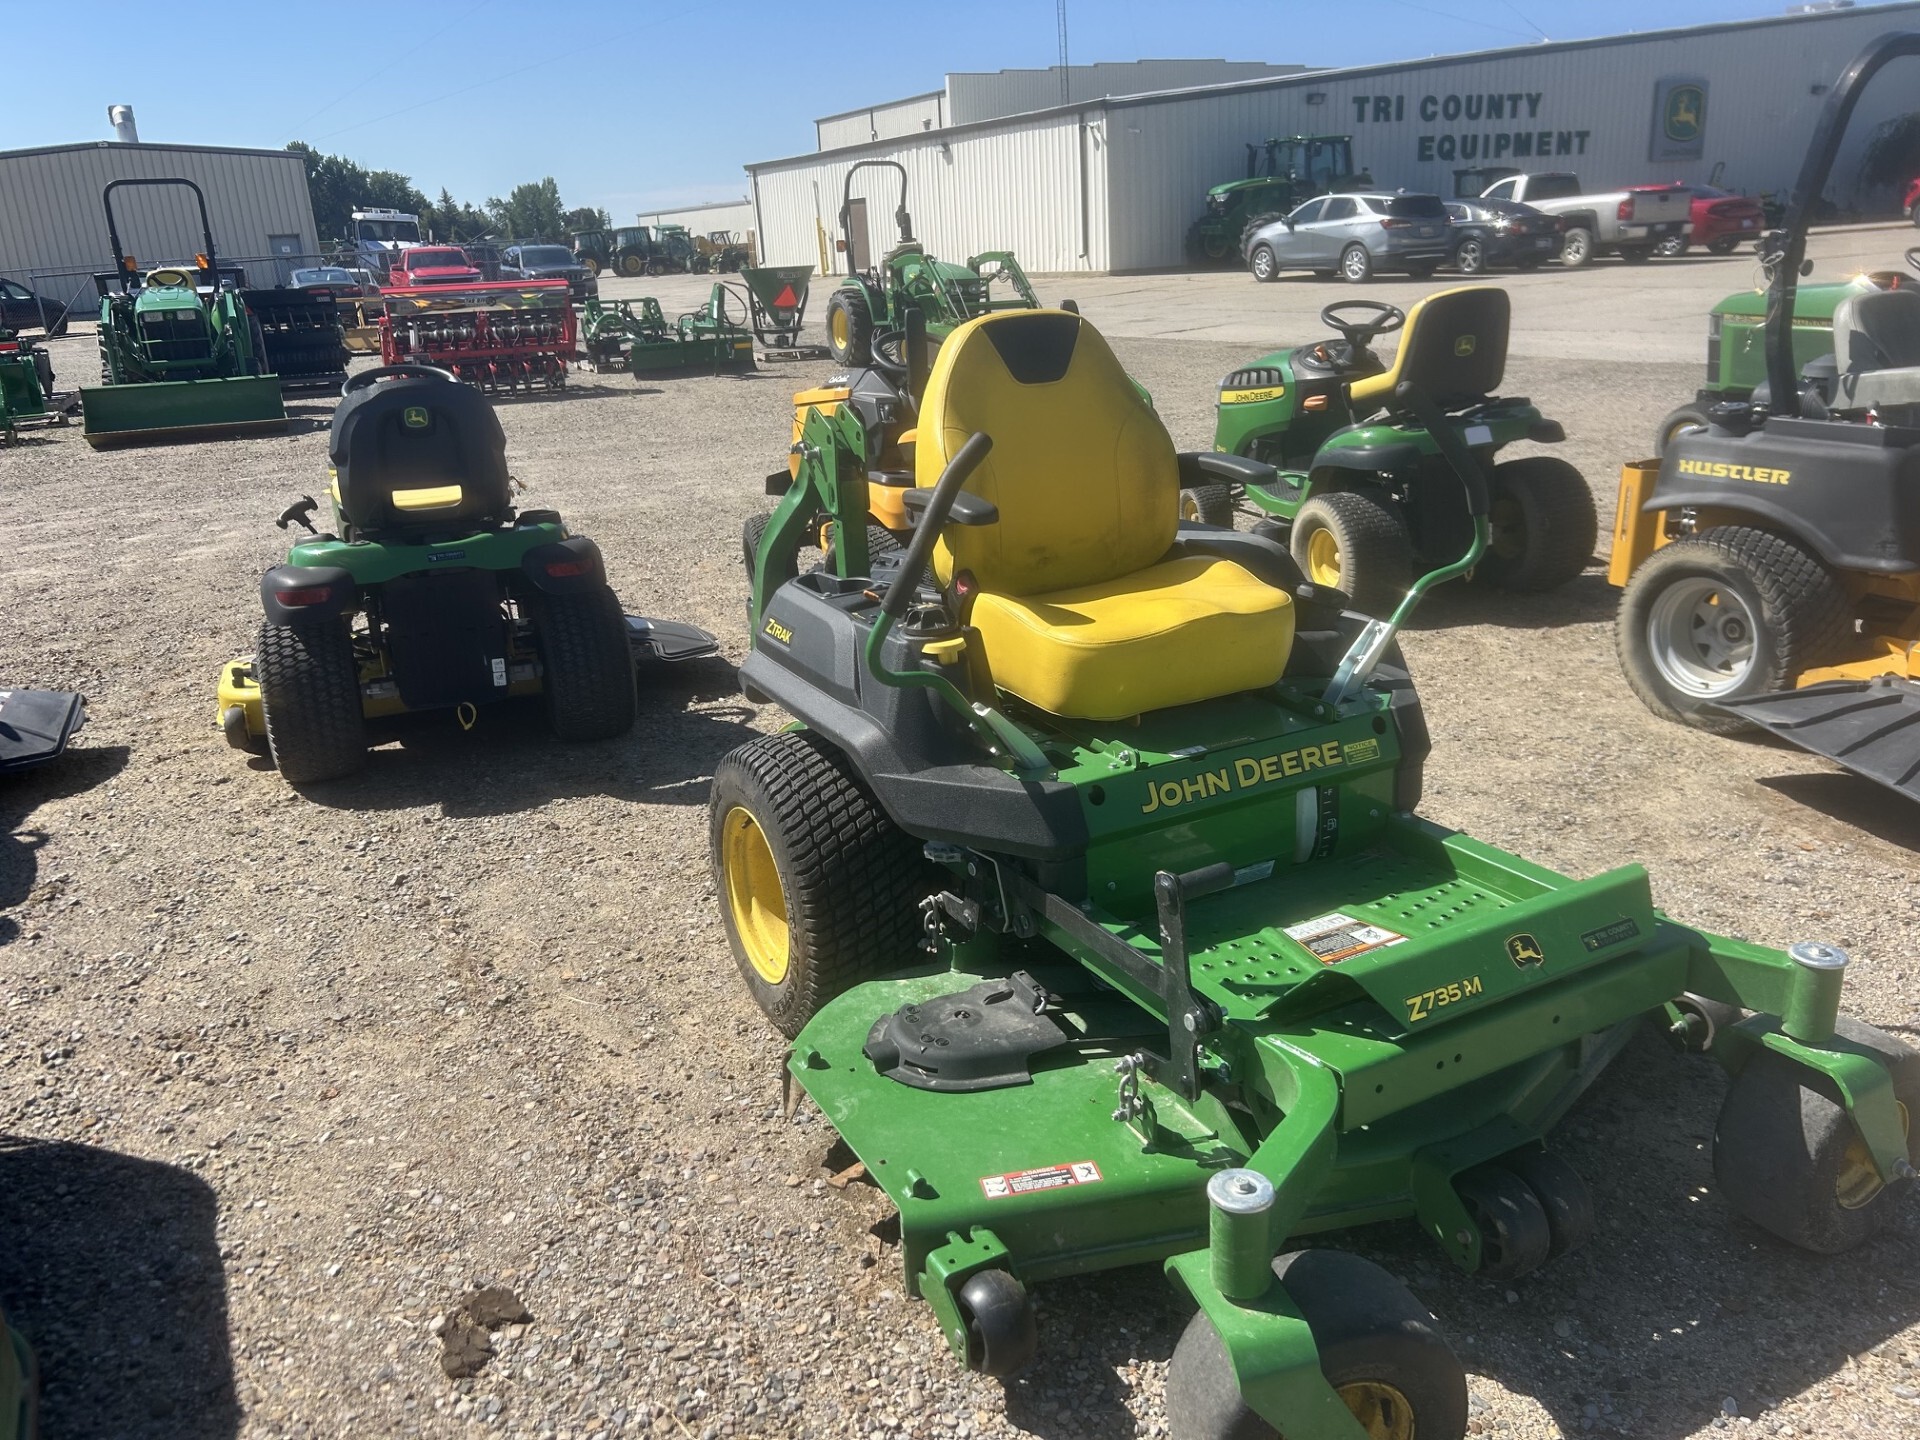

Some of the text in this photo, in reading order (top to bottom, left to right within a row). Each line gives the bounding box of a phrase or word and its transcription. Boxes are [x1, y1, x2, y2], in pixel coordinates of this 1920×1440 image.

[1352, 93, 1543, 123] TRI COUNTY
[1417, 130, 1590, 162] EQUIPMENT
[1235, 390, 1273, 402] JOHN DEERE
[1679, 459, 1790, 485] HUSTLER
[765, 617, 793, 644] ZTRAK
[1347, 740, 1375, 750] NOTICE
[1142, 740, 1343, 813] JOHN DEERE
